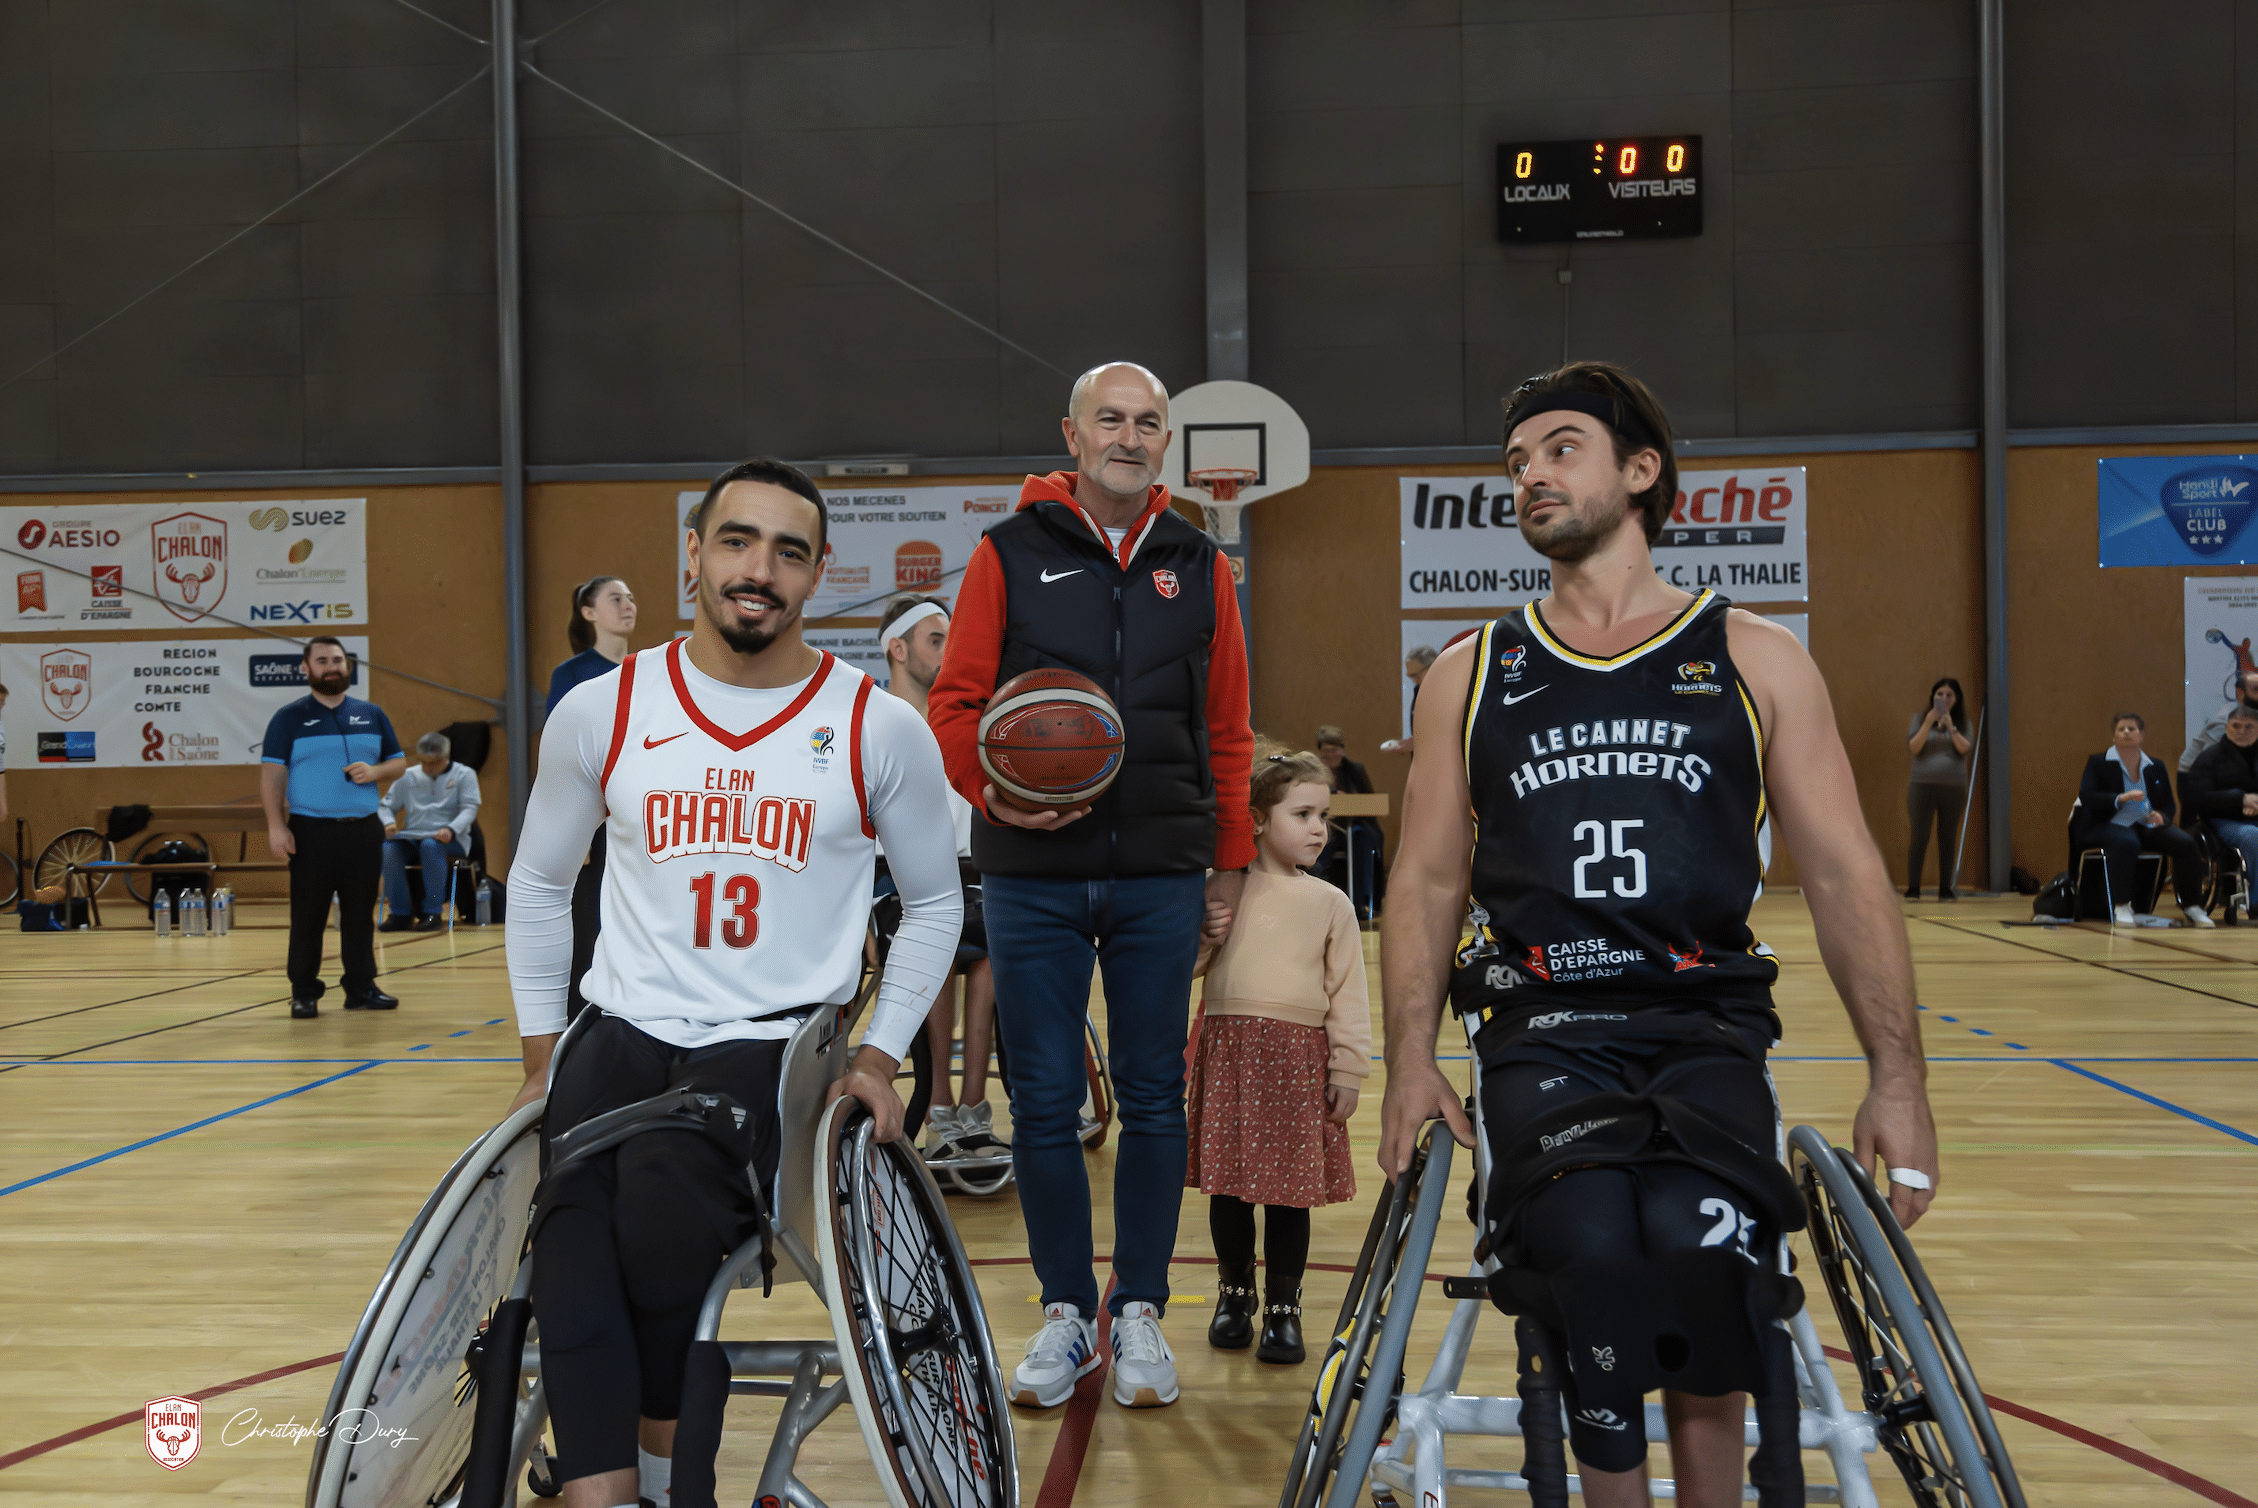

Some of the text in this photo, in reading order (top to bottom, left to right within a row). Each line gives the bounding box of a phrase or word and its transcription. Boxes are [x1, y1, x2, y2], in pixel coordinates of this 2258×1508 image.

[1515, 151, 1533, 179] 0
[1619, 144, 1685, 174] 0 0
[1504, 183, 1571, 203] LOCAUX
[1607, 178, 1696, 199] VISITEURS
[827, 497, 850, 506] NOS
[859, 512, 895, 523] VOTRE
[899, 511, 946, 522] SOUTIEN
[2186, 519, 2227, 531] CLUB
[48, 529, 120, 548] AESIO
[158, 535, 222, 563] CHALON
[896, 567, 942, 583] KING
[1697, 564, 1722, 586] LA
[1728, 562, 1801, 585] THALIE
[44, 664, 87, 682] CHALON
[134, 666, 220, 677] BOURGOGNE
[145, 683, 210, 695] FRANCHE
[134, 702, 182, 712] COMTE
[168, 732, 220, 747] Chalon
[1529, 718, 1691, 758] LE CANNET
[704, 768, 755, 792] ELAN
[643, 791, 816, 874] CHALON
[1573, 818, 1648, 899] 25
[689, 870, 762, 950] 13
[1547, 938, 1609, 957] CAISSE
[1550, 949, 1646, 972] D'EPARGNE
[1553, 965, 1624, 983] Côte d'Azur
